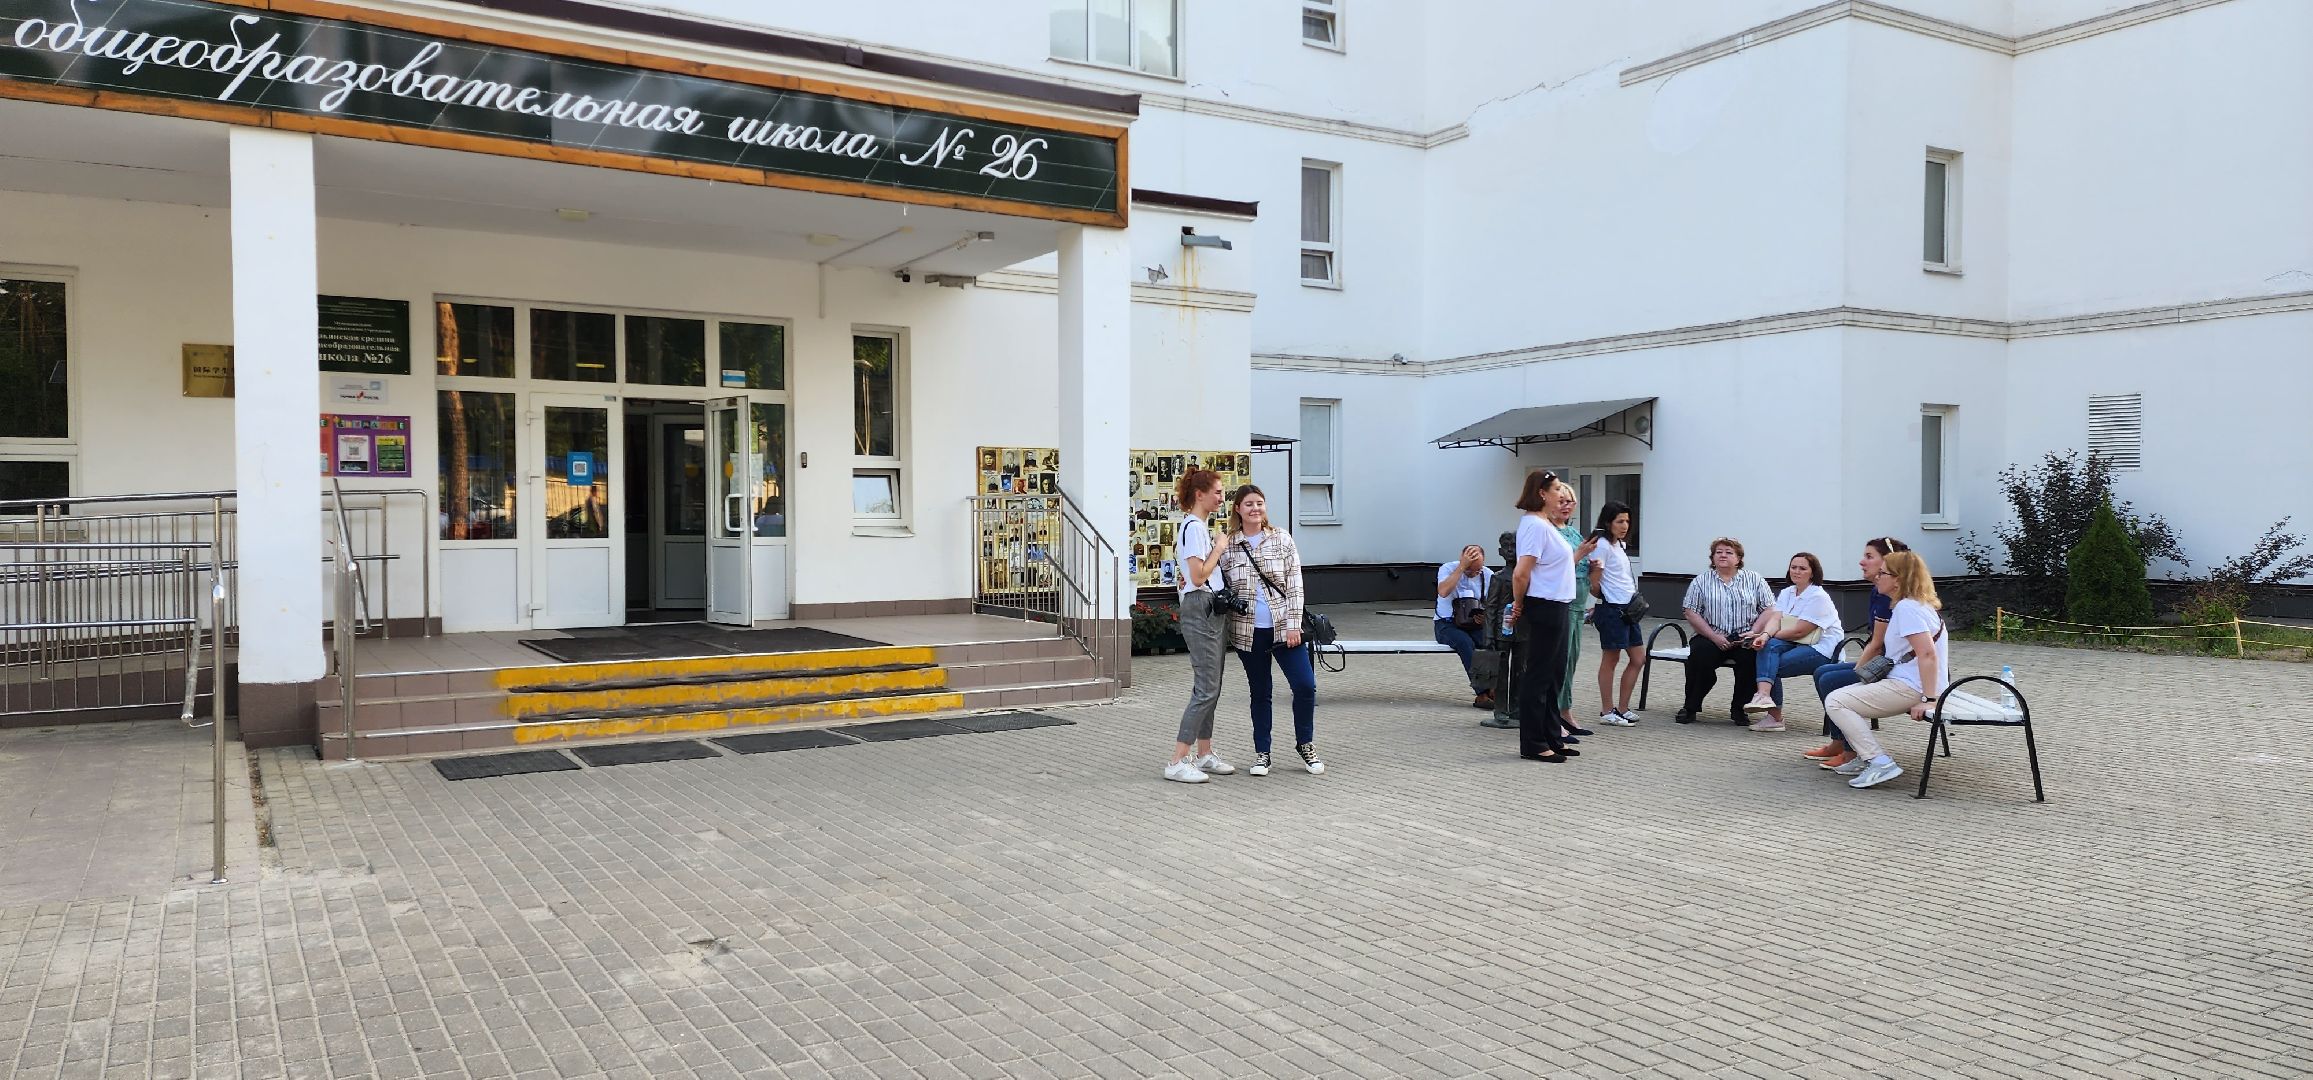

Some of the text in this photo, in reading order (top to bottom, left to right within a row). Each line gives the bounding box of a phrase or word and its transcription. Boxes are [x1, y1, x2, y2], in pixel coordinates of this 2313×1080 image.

[14, 0, 1049, 181] общеобразовательная школа № 26
[362, 353, 392, 364] №26
